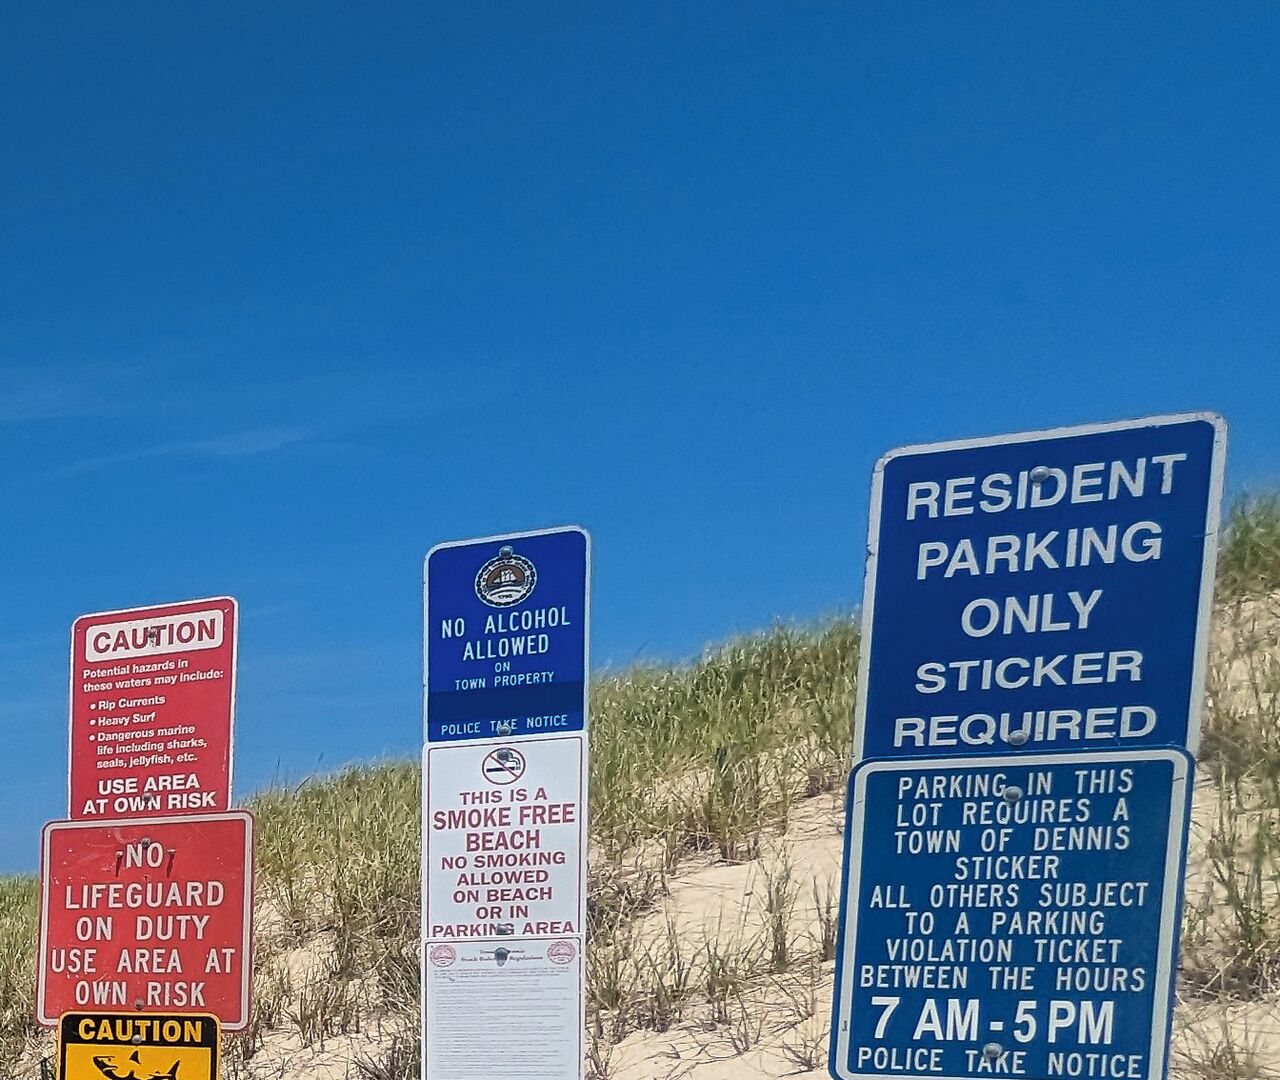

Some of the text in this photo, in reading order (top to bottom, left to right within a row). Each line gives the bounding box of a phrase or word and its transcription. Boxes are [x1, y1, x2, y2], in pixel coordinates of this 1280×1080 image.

[906, 453, 1188, 521] RESIDENT
[917, 521, 1162, 580] PARKING
[442, 606, 571, 638] NO ALCOHOL
[961, 589, 1103, 638] ONLY
[93, 618, 215, 653] CAUTION
[463, 634, 549, 661] ALLOWED
[83, 659, 188, 679] Potential hazards in
[115, 676, 151, 689] waters
[154, 674, 177, 685] may
[180, 669, 224, 682] include:
[495, 662, 510, 672] ON
[915, 650, 1144, 694] STICKER
[455, 672, 554, 690] TOWN PROPERTY
[98, 695, 165, 710] Rip Currents
[98, 712, 156, 726] Heavy Surf
[441, 722, 481, 735] POLICE
[527, 715, 568, 727] NOTICE
[894, 705, 1157, 748] REQUIRED
[98, 725, 195, 742] Dangerous marine
[97, 738, 207, 755] life including sharks,
[97, 754, 198, 769] seals, jellyfish, etc.
[98, 774, 200, 795] USE AREA
[898, 769, 1134, 799] PARKING IN THIS
[83, 791, 216, 815] AT OWN RISK
[460, 788, 547, 805] THIS IS A
[433, 803, 575, 830] SMOKE FREE
[897, 798, 1129, 827] LOT REQUIRES A
[466, 829, 540, 852] BEACH
[895, 826, 1130, 854] TOWN OF DENNIS
[126, 842, 164, 868] NO
[442, 851, 565, 869] NO SMOKING
[457, 870, 549, 886] ALLOWED
[955, 855, 1060, 880] STICKER
[66, 881, 225, 909] LIFEGUARD
[453, 887, 552, 903] ON BEACH
[870, 883, 1149, 908] ALL OTHERS SUBJECT
[476, 905, 528, 919] OR IN
[906, 912, 1105, 935] TO A PARKING
[76, 915, 210, 941] ON DUTY
[522, 922, 575, 934] AREA
[51, 949, 235, 973] USE AREA AT
[886, 939, 1123, 963] VIOLATION TICKET
[860, 966, 1146, 992] BETWEEN THE HOURS
[75, 980, 206, 1006] OWN RISK
[78, 1019, 202, 1042] CAUTION
[871, 997, 901, 1038] 7
[1048, 1001, 1114, 1045] PM
[858, 1047, 1143, 1078] POLICE TAKE NOTICE
